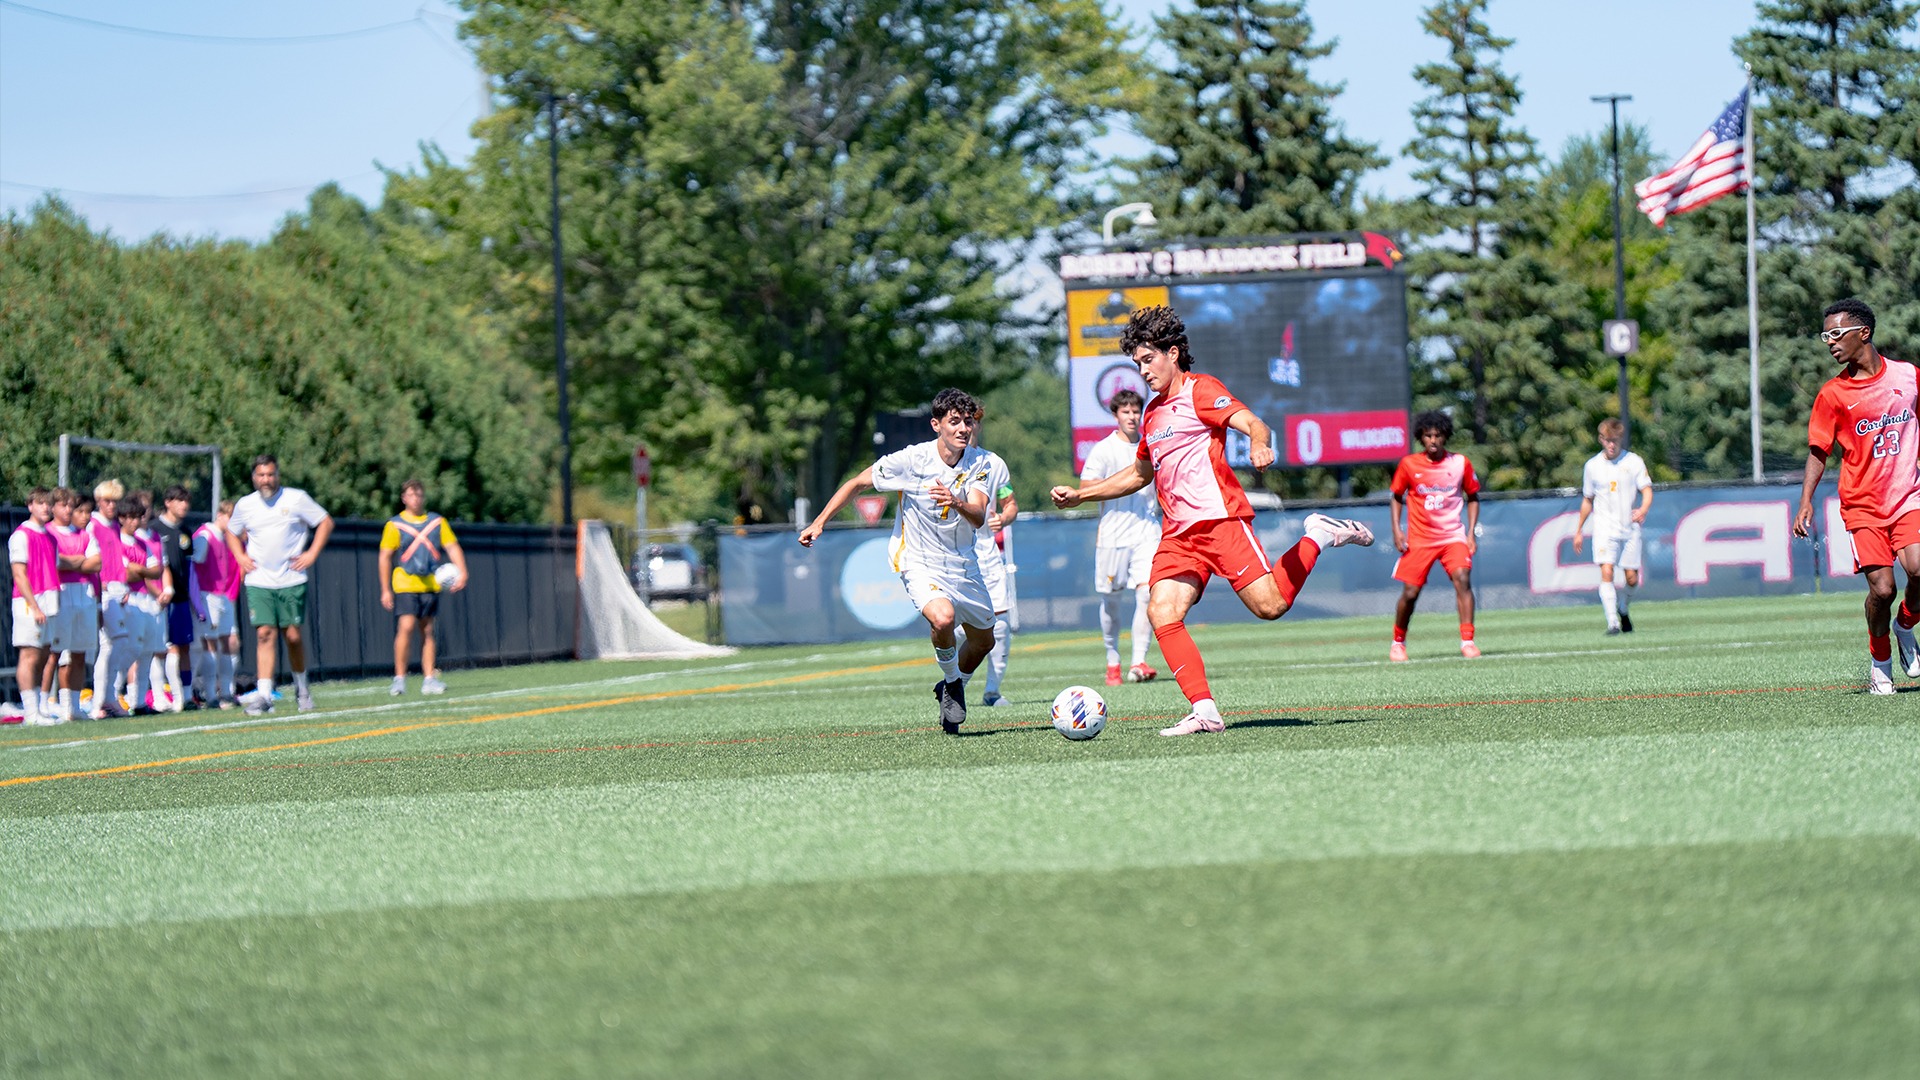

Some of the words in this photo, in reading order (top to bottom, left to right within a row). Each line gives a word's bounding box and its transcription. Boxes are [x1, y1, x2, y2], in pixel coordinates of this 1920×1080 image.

[1060, 252, 1152, 278] ROBERT
[1153, 251, 1173, 275] C
[1299, 242, 1366, 269] FIELD
[1610, 323, 1631, 353] C
[1146, 425, 1174, 446] ardinals
[1856, 408, 1911, 436] Cardinals
[1297, 419, 1323, 465] 0
[1873, 430, 1901, 459] 23
